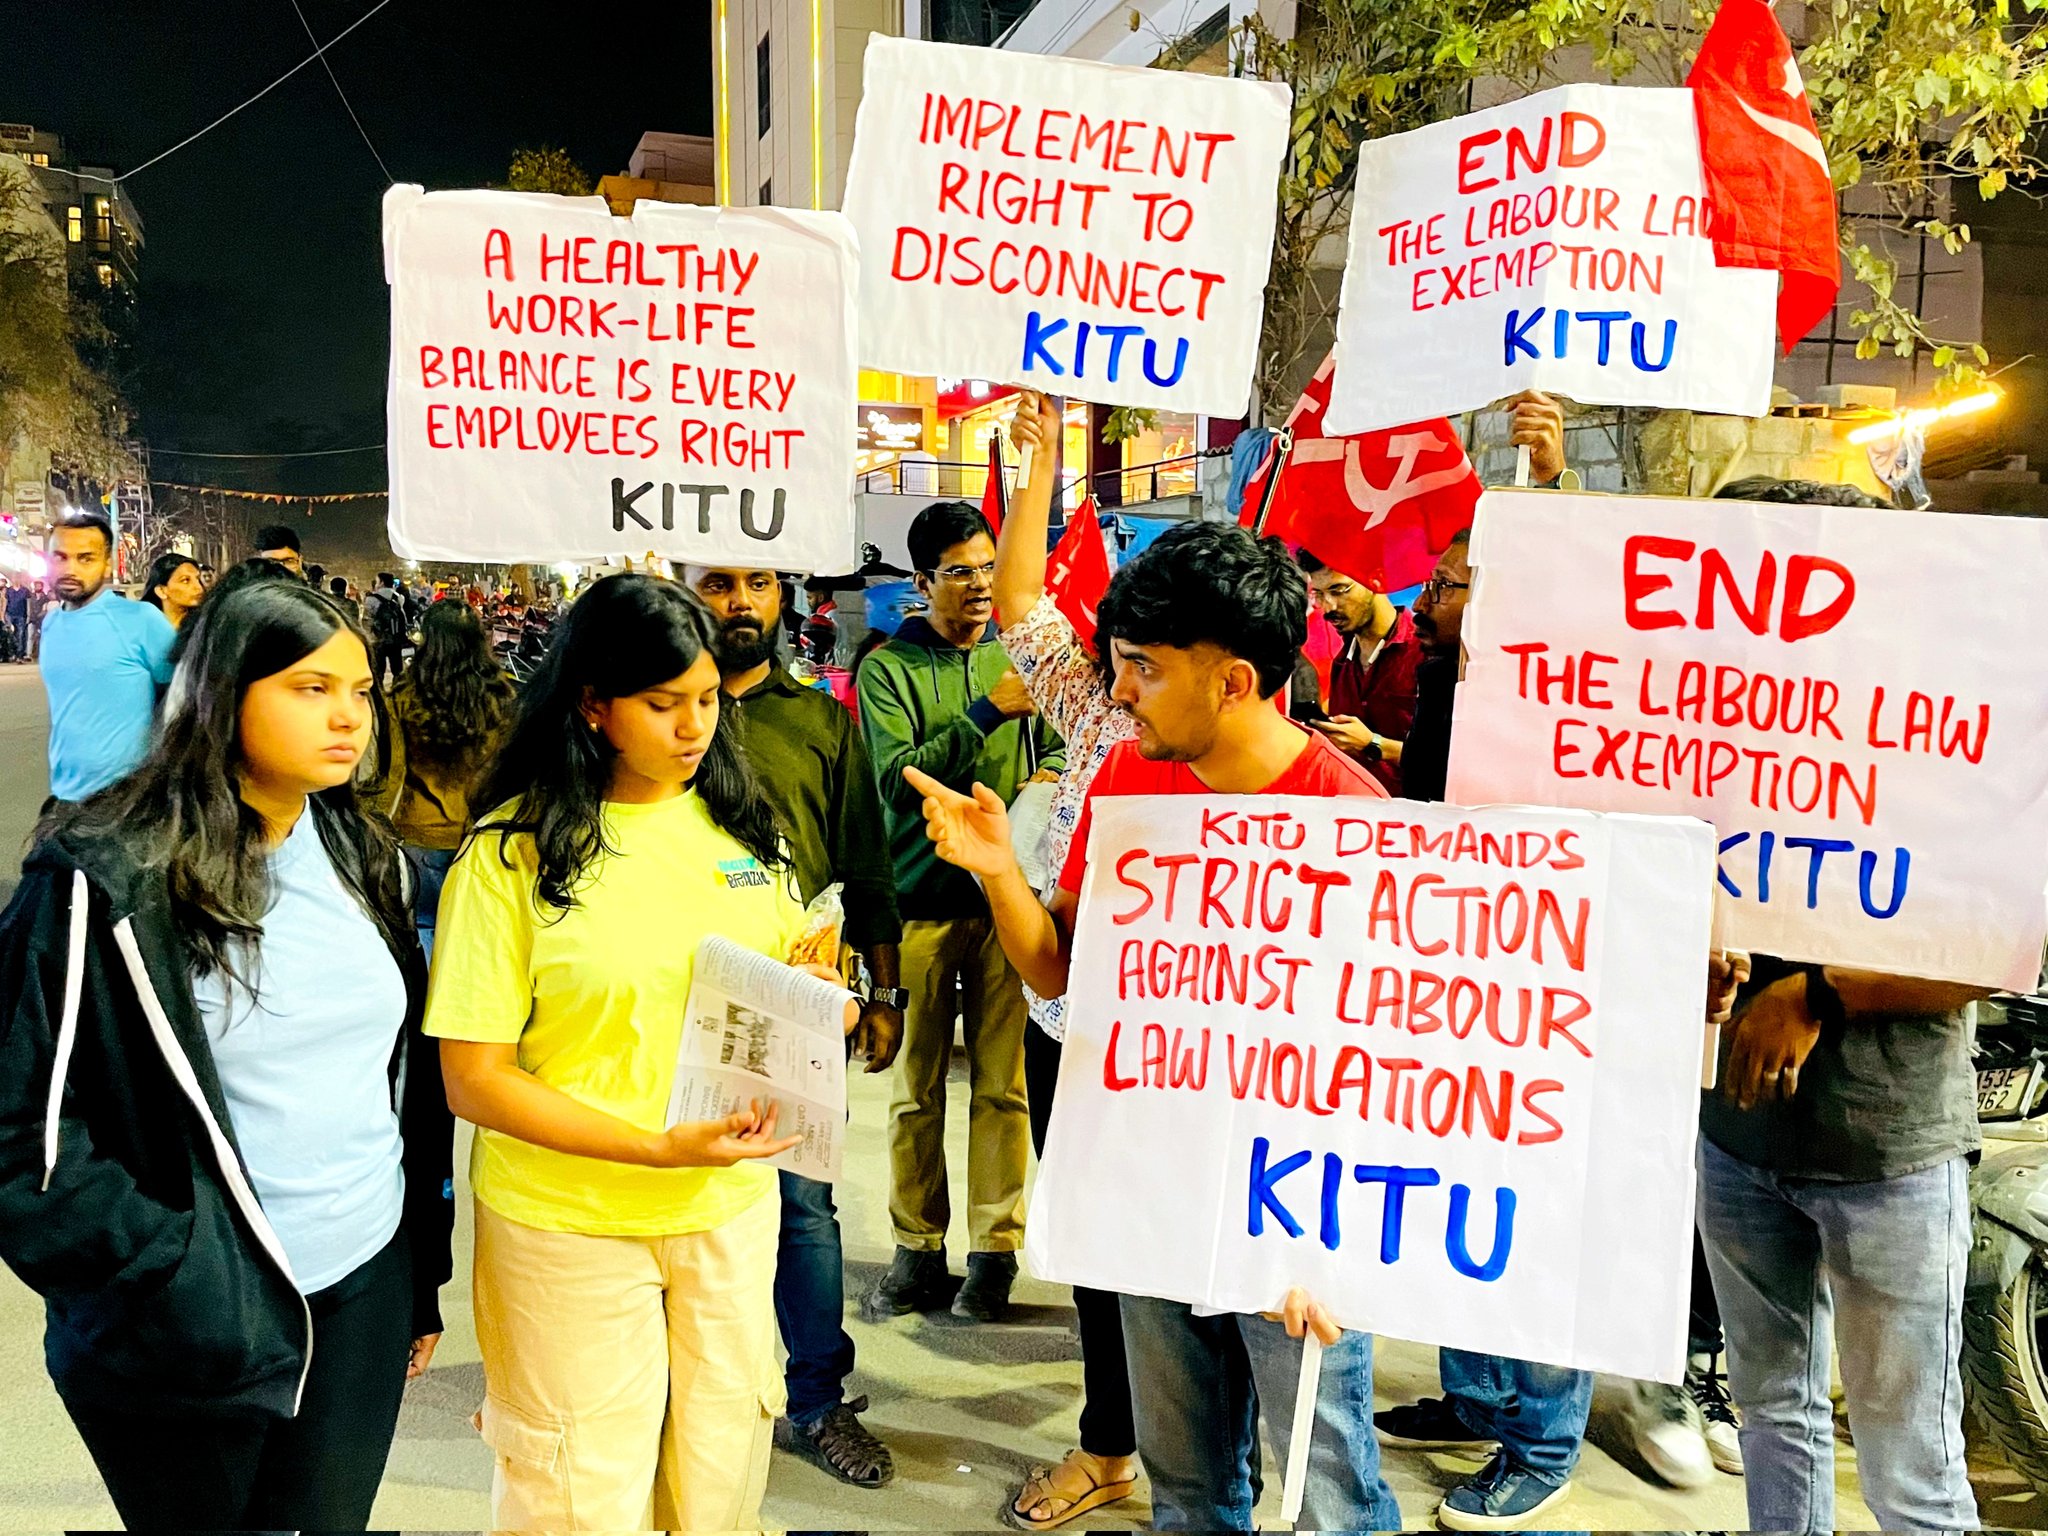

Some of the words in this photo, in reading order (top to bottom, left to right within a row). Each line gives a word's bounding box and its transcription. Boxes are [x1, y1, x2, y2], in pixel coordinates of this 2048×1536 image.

[918, 91, 1237, 184] IMPLEMENT
[1457, 110, 1607, 196] END
[937, 161, 1112, 232] RIGHT
[1131, 191, 1195, 243] TO
[1377, 213, 1446, 267] THE
[1464, 186, 1621, 248] LABOUR
[483, 227, 516, 283] A
[539, 232, 760, 297] HEALTHY
[890, 225, 1226, 322] DISCONNECT
[1411, 240, 1664, 312] EXEMPTION
[486, 288, 757, 350] WORK-LIFE
[1021, 310, 1190, 388] KITU
[1503, 306, 1678, 373] KITU
[419, 344, 597, 399] BALANCE
[616, 357, 653, 404] IS
[670, 362, 797, 414] EVERY
[426, 403, 660, 460] EMPLOYEES
[680, 418, 806, 473] RIGHT
[611, 477, 787, 542] KITU
[1622, 534, 1857, 644] END
[1499, 640, 1620, 711] THE
[1637, 657, 1845, 742] LABOUR
[1866, 685, 1991, 766] LAW
[1552, 717, 1878, 827] EXEMPTION
[1199, 807, 1307, 851] KITU
[1333, 817, 1585, 872] DEMANDS
[1111, 847, 1353, 939] STRICT
[1367, 868, 1591, 973] ACTION
[1117, 938, 1313, 1016] AGAINST
[1335, 961, 1593, 1059] LABOUR
[1102, 1019, 1212, 1093] LAW
[1226, 1033, 1565, 1147] VIOLATIONS
[1247, 1136, 1518, 1283] KITU
